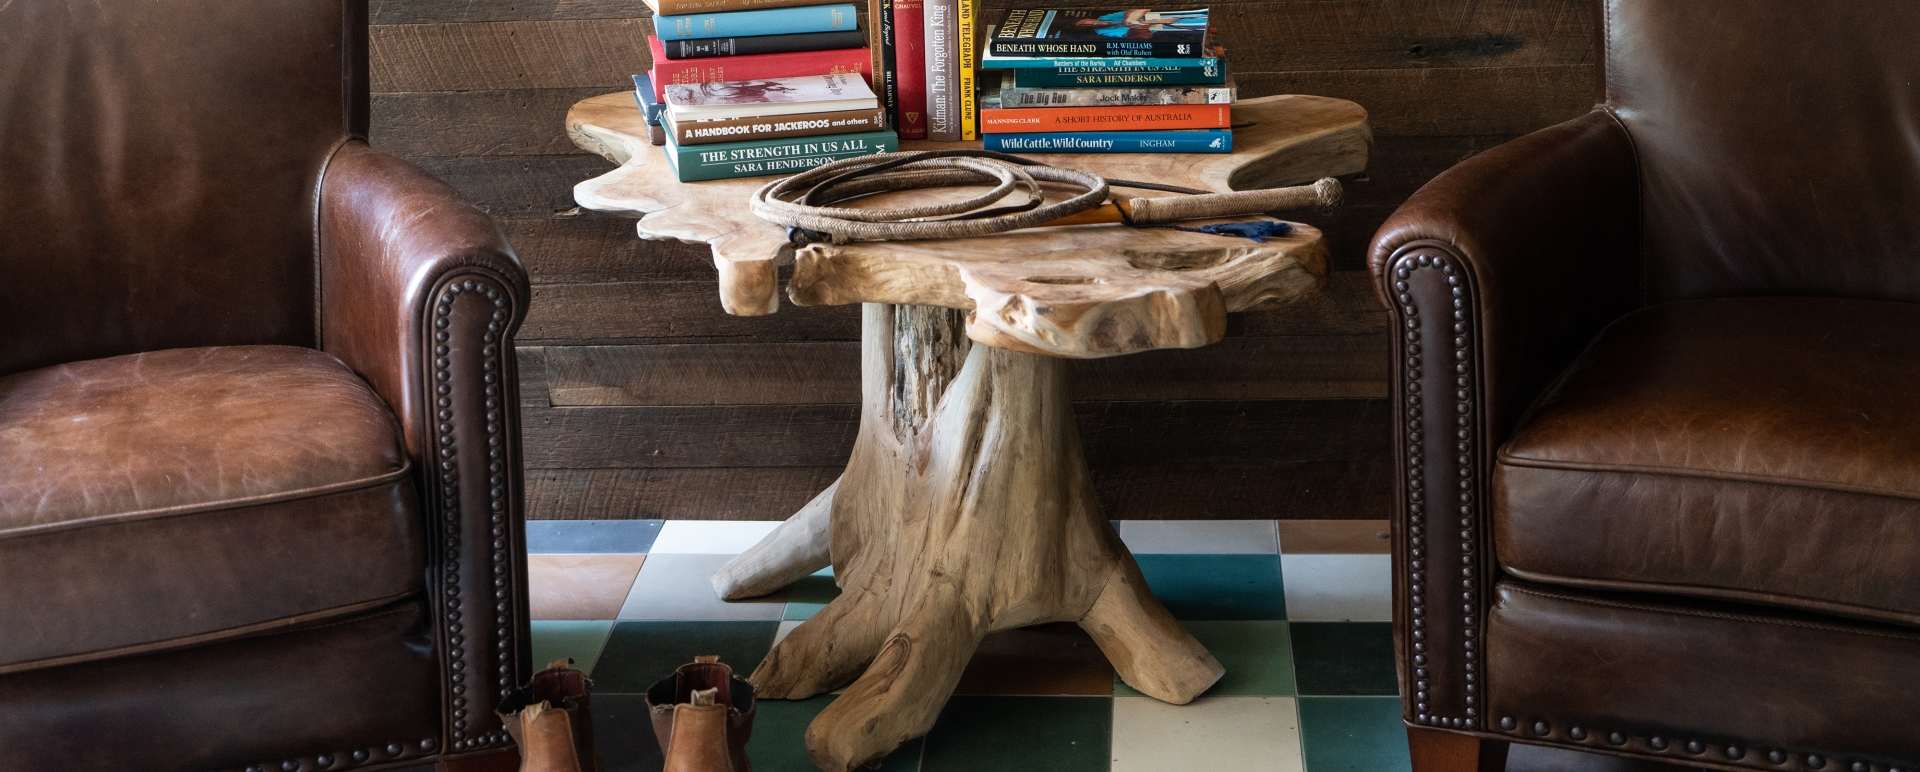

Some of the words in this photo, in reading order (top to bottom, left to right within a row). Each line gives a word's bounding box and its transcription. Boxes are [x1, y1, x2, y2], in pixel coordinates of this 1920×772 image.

[930, 5, 947, 27] King
[998, 10, 1027, 38] BENEATH
[930, 30, 947, 72] Forgotten
[962, 22, 971, 68] TELEGRAPH
[996, 44, 1035, 52] BENEATH
[1036, 44, 1069, 52] WHOSE
[1070, 44, 1096, 52] HAND
[931, 75, 945, 93] The
[1104, 75, 1163, 83] HENDERSON
[1020, 93, 1034, 104] The
[1036, 93, 1050, 105] Big
[1052, 93, 1067, 103] Run
[1098, 94, 1119, 102] Jock
[932, 95, 947, 134] Kidman:
[1145, 113, 1192, 121] AUSTRALIA
[685, 130, 693, 138] A
[695, 126, 750, 138] HANDBOOK
[752, 124, 772, 133] FOR
[774, 120, 830, 132] JACKEROOS
[832, 119, 845, 127] and
[847, 118, 868, 126] others
[700, 151, 728, 162] THE
[731, 144, 801, 160] STRENGTH
[804, 143, 818, 154] IN
[822, 141, 838, 152] US
[842, 139, 867, 151] ALL
[1001, 138, 1023, 149] Wild
[1053, 137, 1075, 148] Wild
[1075, 138, 1113, 149] Country
[734, 163, 763, 173] SARA
[767, 157, 835, 170] HENDERSON
